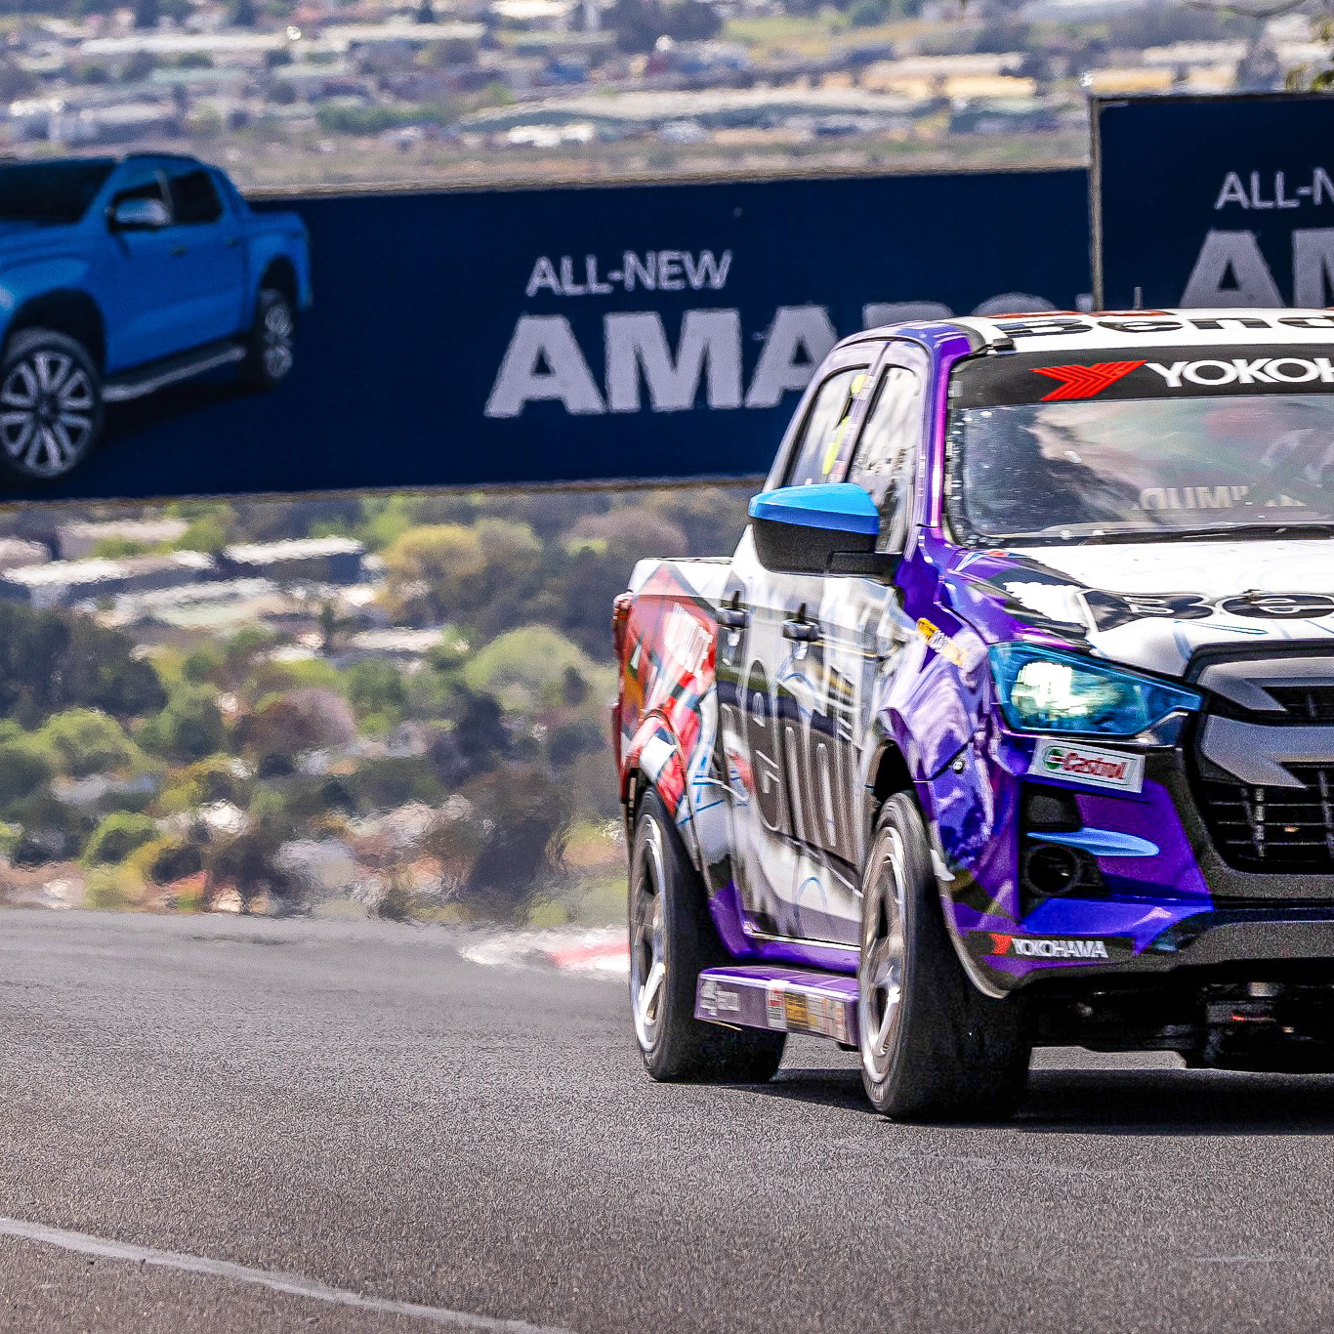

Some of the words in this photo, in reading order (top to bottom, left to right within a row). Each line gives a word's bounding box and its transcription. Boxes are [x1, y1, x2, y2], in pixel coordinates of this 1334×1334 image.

[526, 250, 733, 296] ALL-NEW
[483, 293, 1092, 418] AMA
[1063, 752, 1127, 780] Castrol
[1011, 938, 1109, 958] YOKOHAMA
